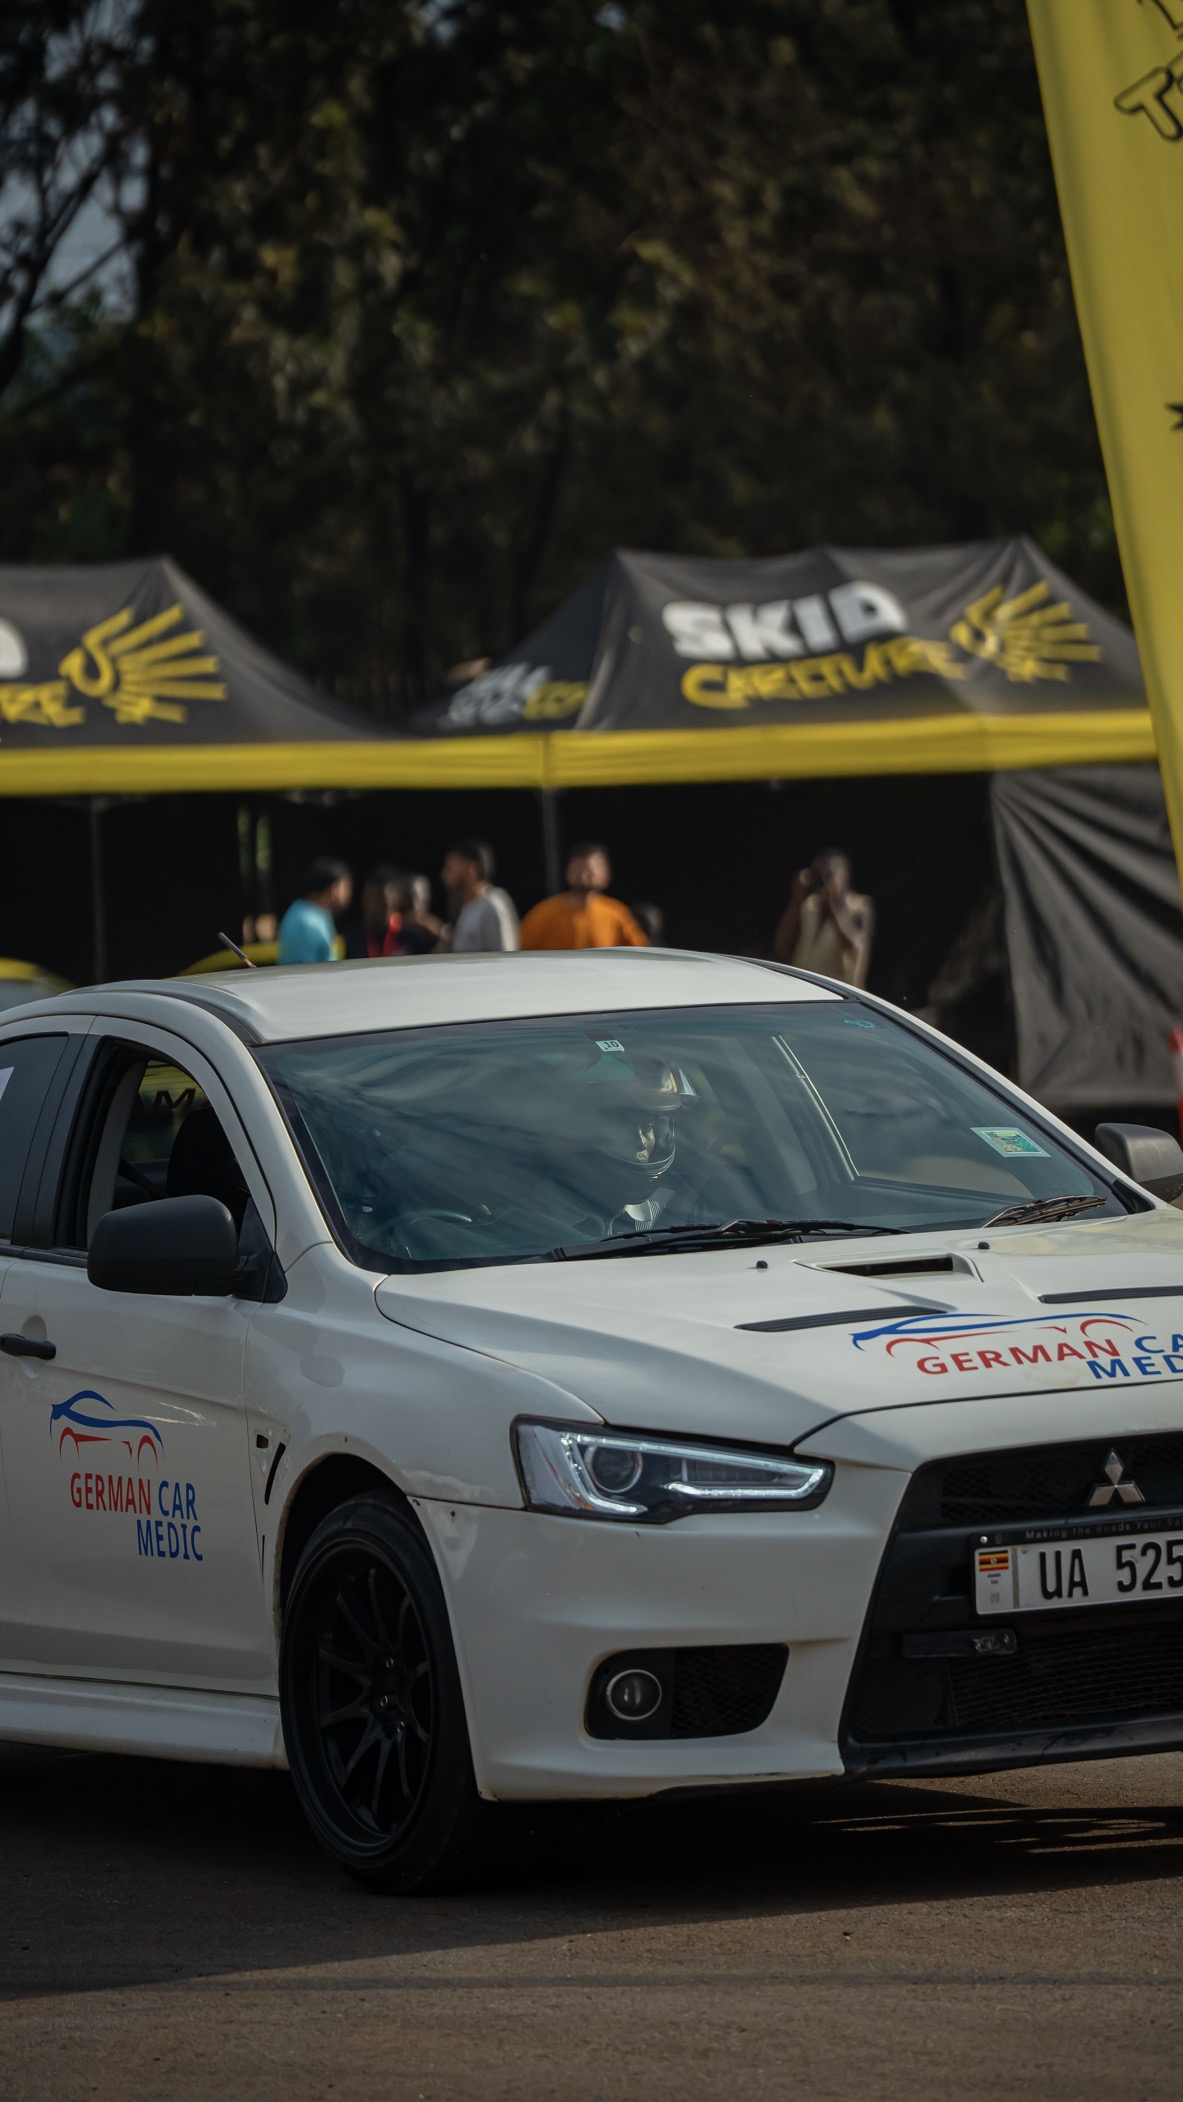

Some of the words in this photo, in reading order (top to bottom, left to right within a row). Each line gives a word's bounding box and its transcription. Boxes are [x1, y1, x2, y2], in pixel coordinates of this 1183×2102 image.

[662, 580, 907, 661] SKID
[917, 1338, 1121, 1375] GERMAN
[70, 1471, 152, 1516] GERMAN
[158, 1480, 198, 1521] CAR
[136, 1519, 204, 1562] MEDIC
[1025, 1528, 1068, 1539] Making
[1073, 1526, 1091, 1535] the
[1136, 1519, 1162, 1530] Your
[1039, 1548, 1089, 1600] UA
[1115, 1538, 1183, 1593] 525
